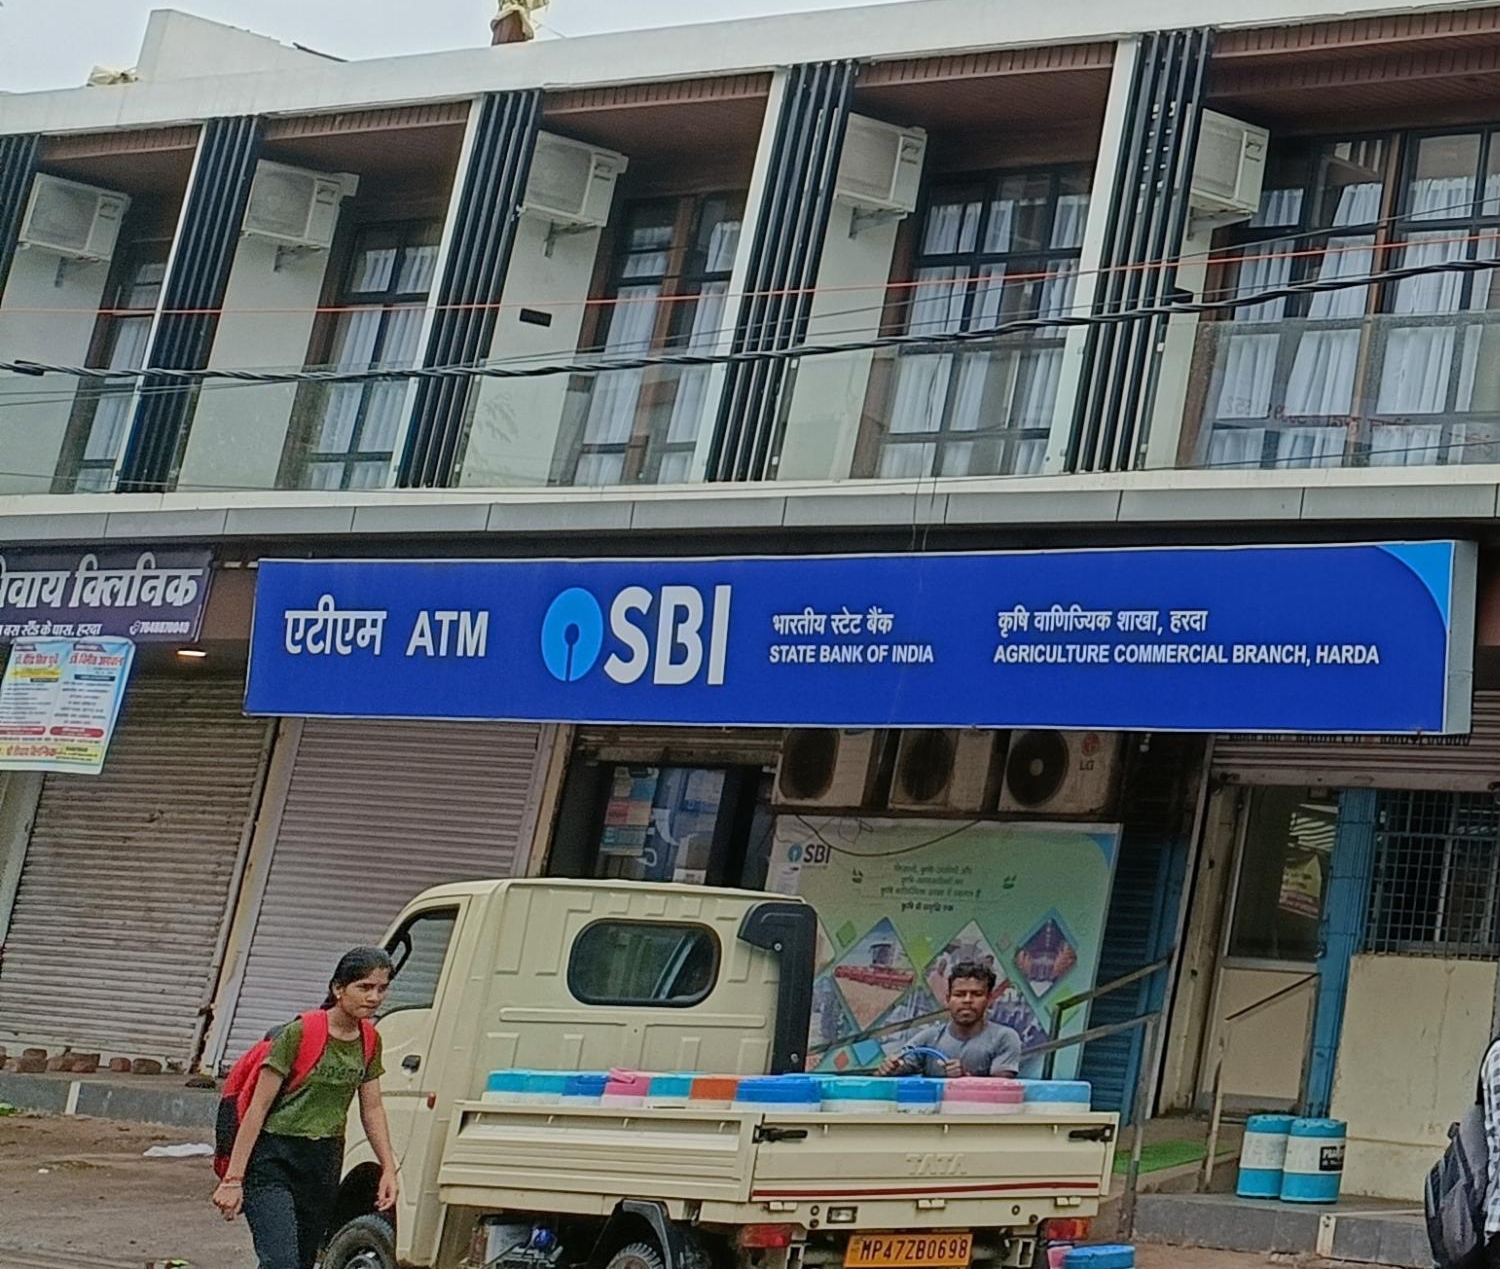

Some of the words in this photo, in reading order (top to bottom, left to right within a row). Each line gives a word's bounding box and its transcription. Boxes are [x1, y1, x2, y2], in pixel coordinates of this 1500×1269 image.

[0, 554, 71, 608] वाय
[68, 551, 203, 608] क्लिनिक
[76, 623, 103, 637] हरदा
[284, 594, 387, 656] एटीएम
[405, 610, 490, 658] ATM
[772, 606, 827, 635] भारतीय
[831, 606, 863, 634] स्टेट
[866, 605, 894, 635] बैंक
[997, 604, 1030, 637] कृषि
[1033, 603, 1112, 631] वाणिज्यिक
[1116, 609, 1163, 635] शाखा,
[1169, 609, 1208, 633] हरदा
[603, 584, 732, 686] SBI
[769, 645, 816, 663] STATE
[819, 645, 864, 663] BANK
[866, 645, 889, 663] OF
[891, 645, 934, 663] INDIA
[994, 643, 1109, 663] AGRICULTURE
[1113, 643, 1229, 664] COMMERCIAL
[1232, 644, 1311, 667] BRANCH,
[1315, 644, 1380, 664] HARDA
[1079, 759, 1095, 771] LG
[803, 843, 831, 864] SBI
[905, 1153, 967, 1175] TATA
[859, 1239, 969, 1261] MP47ZB0698
